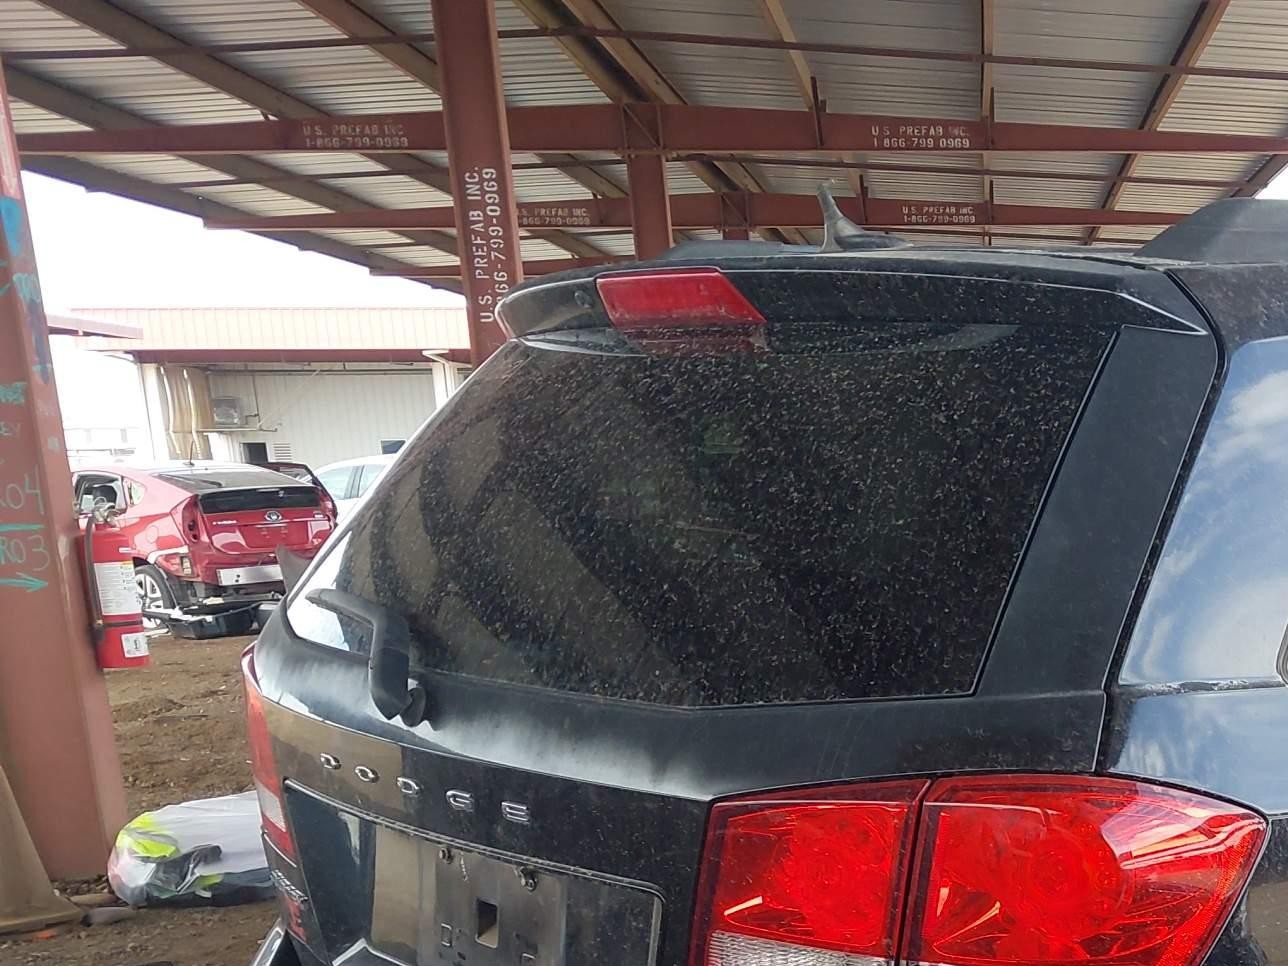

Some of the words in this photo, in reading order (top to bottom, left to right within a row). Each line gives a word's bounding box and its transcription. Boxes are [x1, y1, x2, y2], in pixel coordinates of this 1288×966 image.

[899, 125, 944, 137] PREFAB
[464, 166, 482, 200] INC.
[468, 210, 490, 279] PREFAB
[320, 752, 532, 825] DODGE
